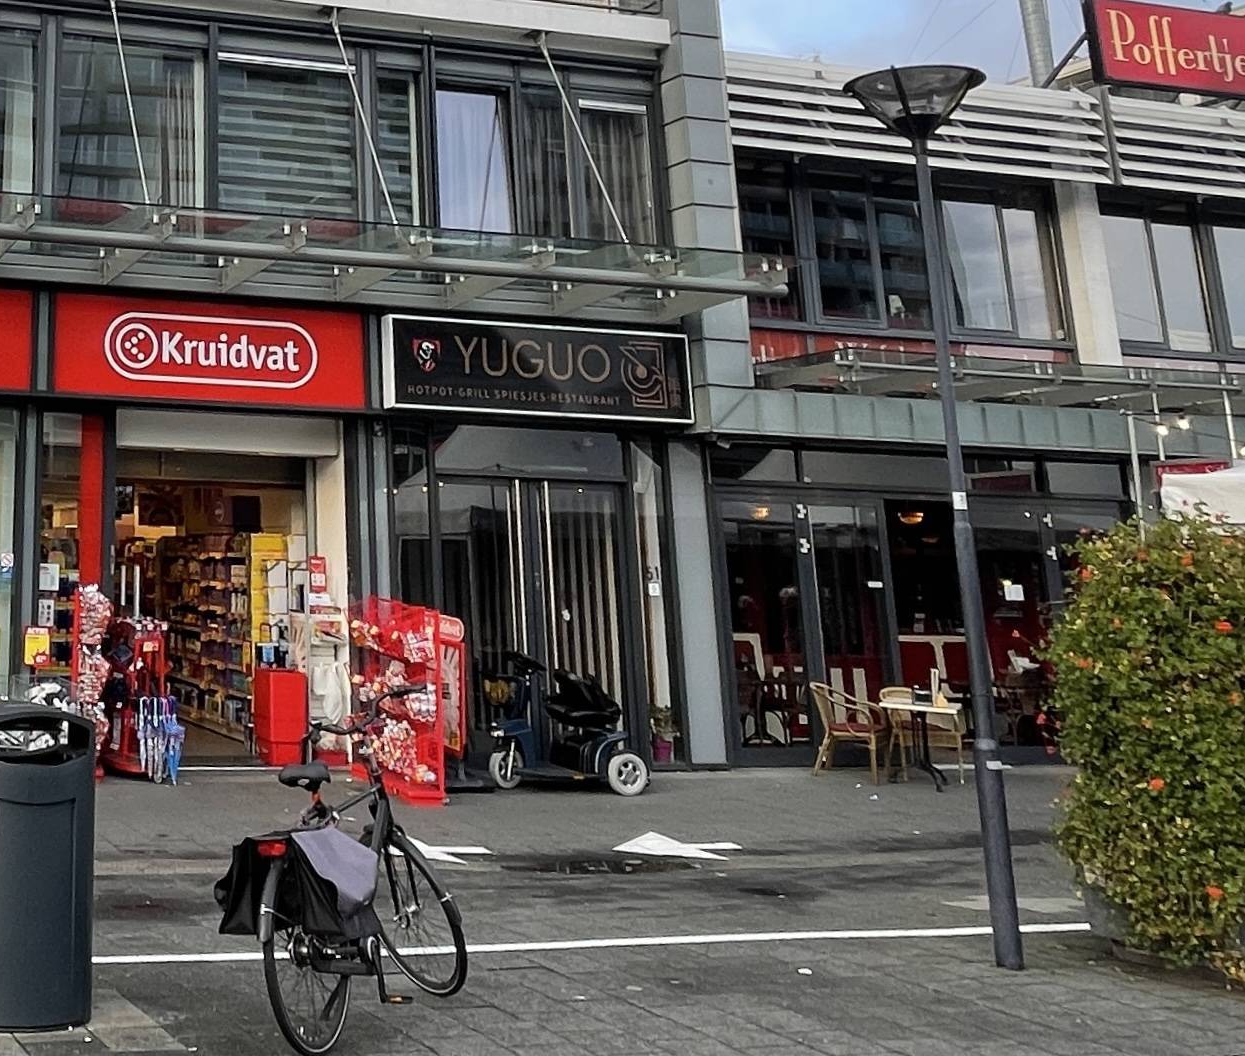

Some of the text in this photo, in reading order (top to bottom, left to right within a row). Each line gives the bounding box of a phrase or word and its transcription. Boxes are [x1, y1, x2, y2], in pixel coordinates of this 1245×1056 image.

[161, 331, 300, 372] Kruidvat
[454, 335, 611, 383] YUGUO
[551, 393, 620, 406] RESTAURANT
